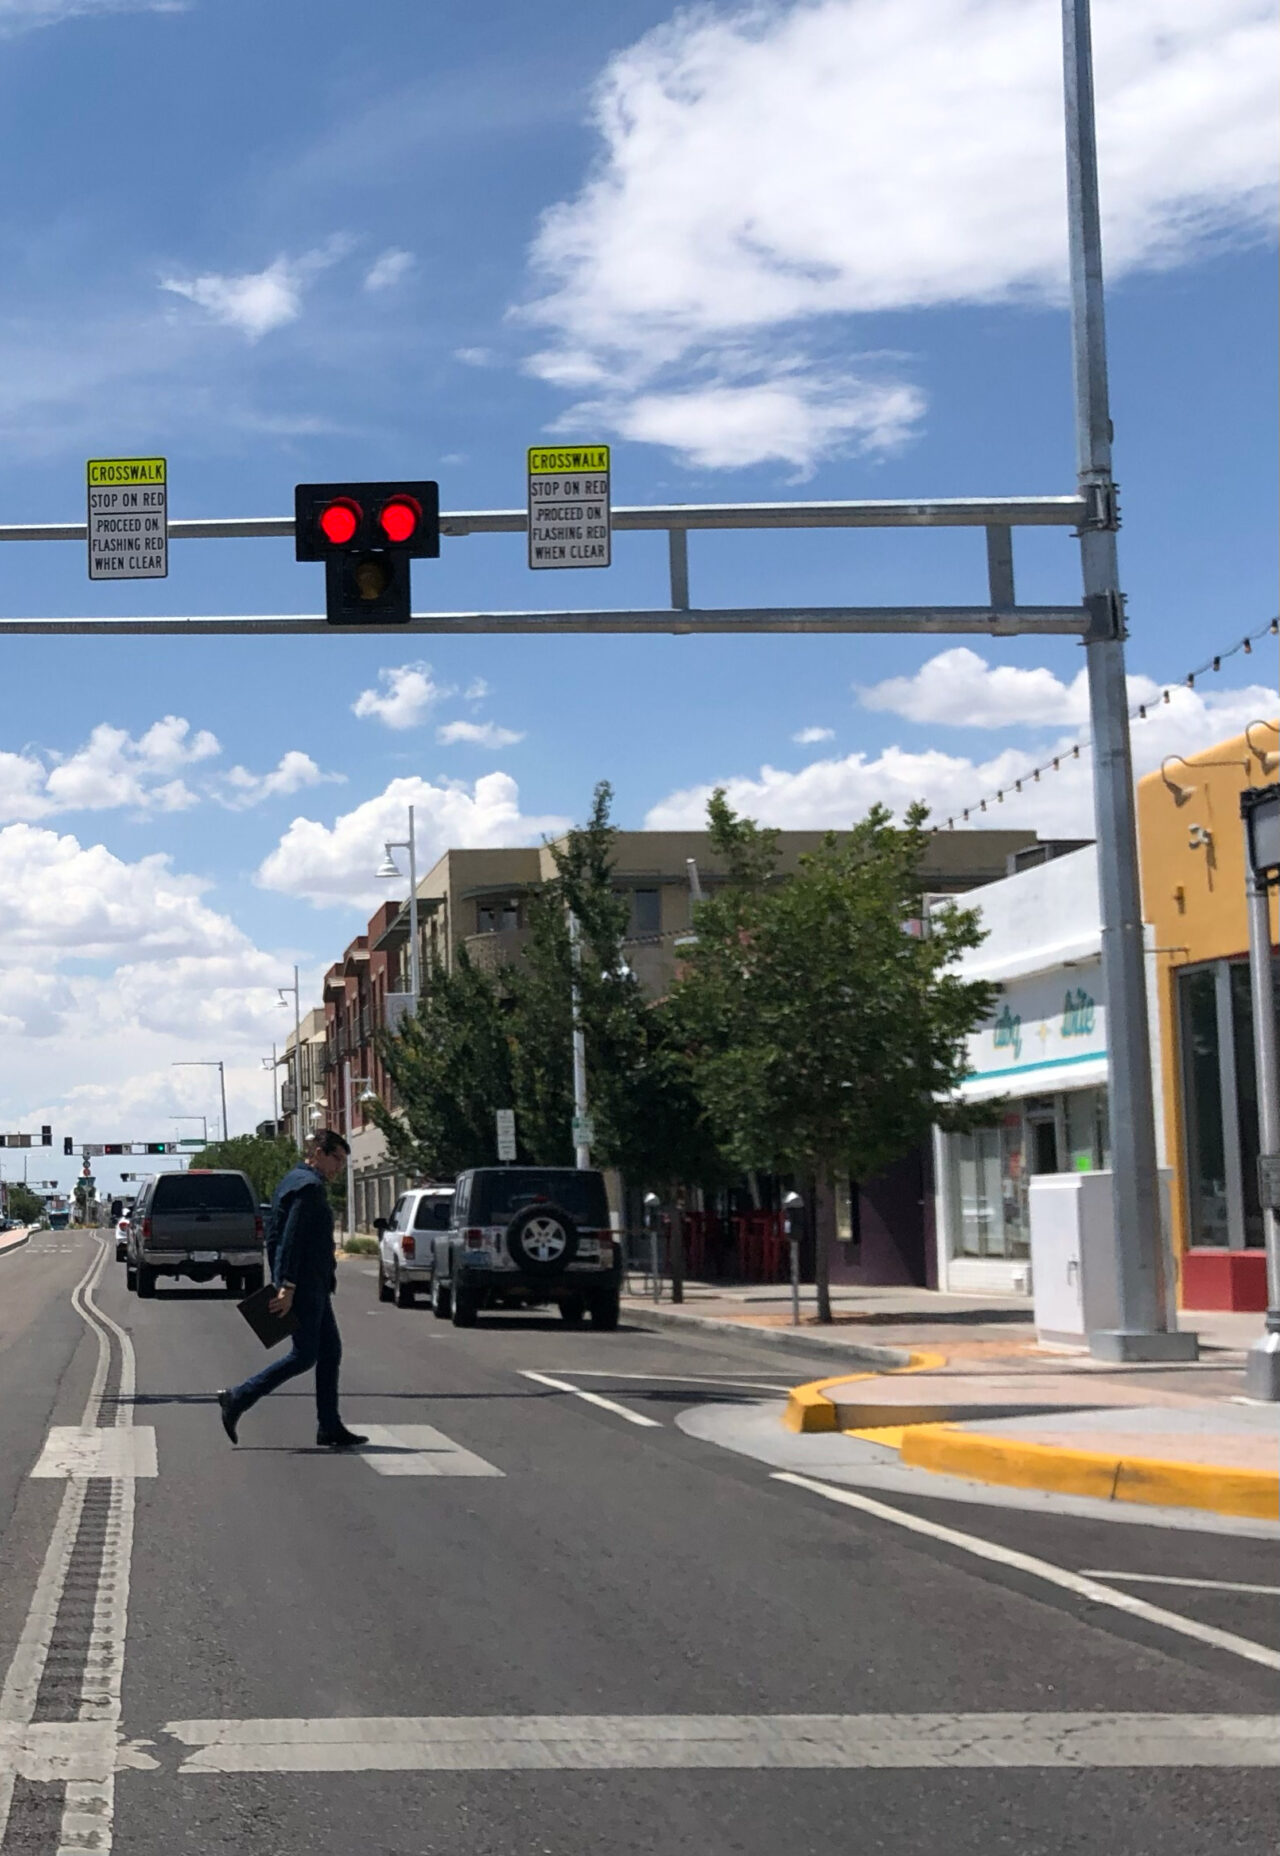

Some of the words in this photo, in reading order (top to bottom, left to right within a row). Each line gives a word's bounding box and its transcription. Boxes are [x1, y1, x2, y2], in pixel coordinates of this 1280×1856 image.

[531, 452, 606, 470] CROSSWALK
[91, 464, 163, 482] CROSSWALK
[531, 481, 560, 497] STOP
[563, 481, 580, 495] ON
[585, 480, 608, 494] RED
[91, 493, 118, 508] STOP
[122, 493, 138, 507] ON
[143, 492, 164, 507] RED
[536, 507, 584, 522] PROCEED
[587, 506, 602, 520] ON
[97, 518, 142, 533] PROCEED
[144, 518, 160, 532] ON
[533, 526, 583, 541] FLASHING
[586, 525, 607, 539] RED
[92, 538, 141, 552] FLASHING
[144, 537, 164, 551] RED
[535, 546, 566, 560] WHEN
[570, 544, 605, 559] CLEAR
[95, 557, 125, 571] WHEN
[129, 555, 162, 570] CLEAR
